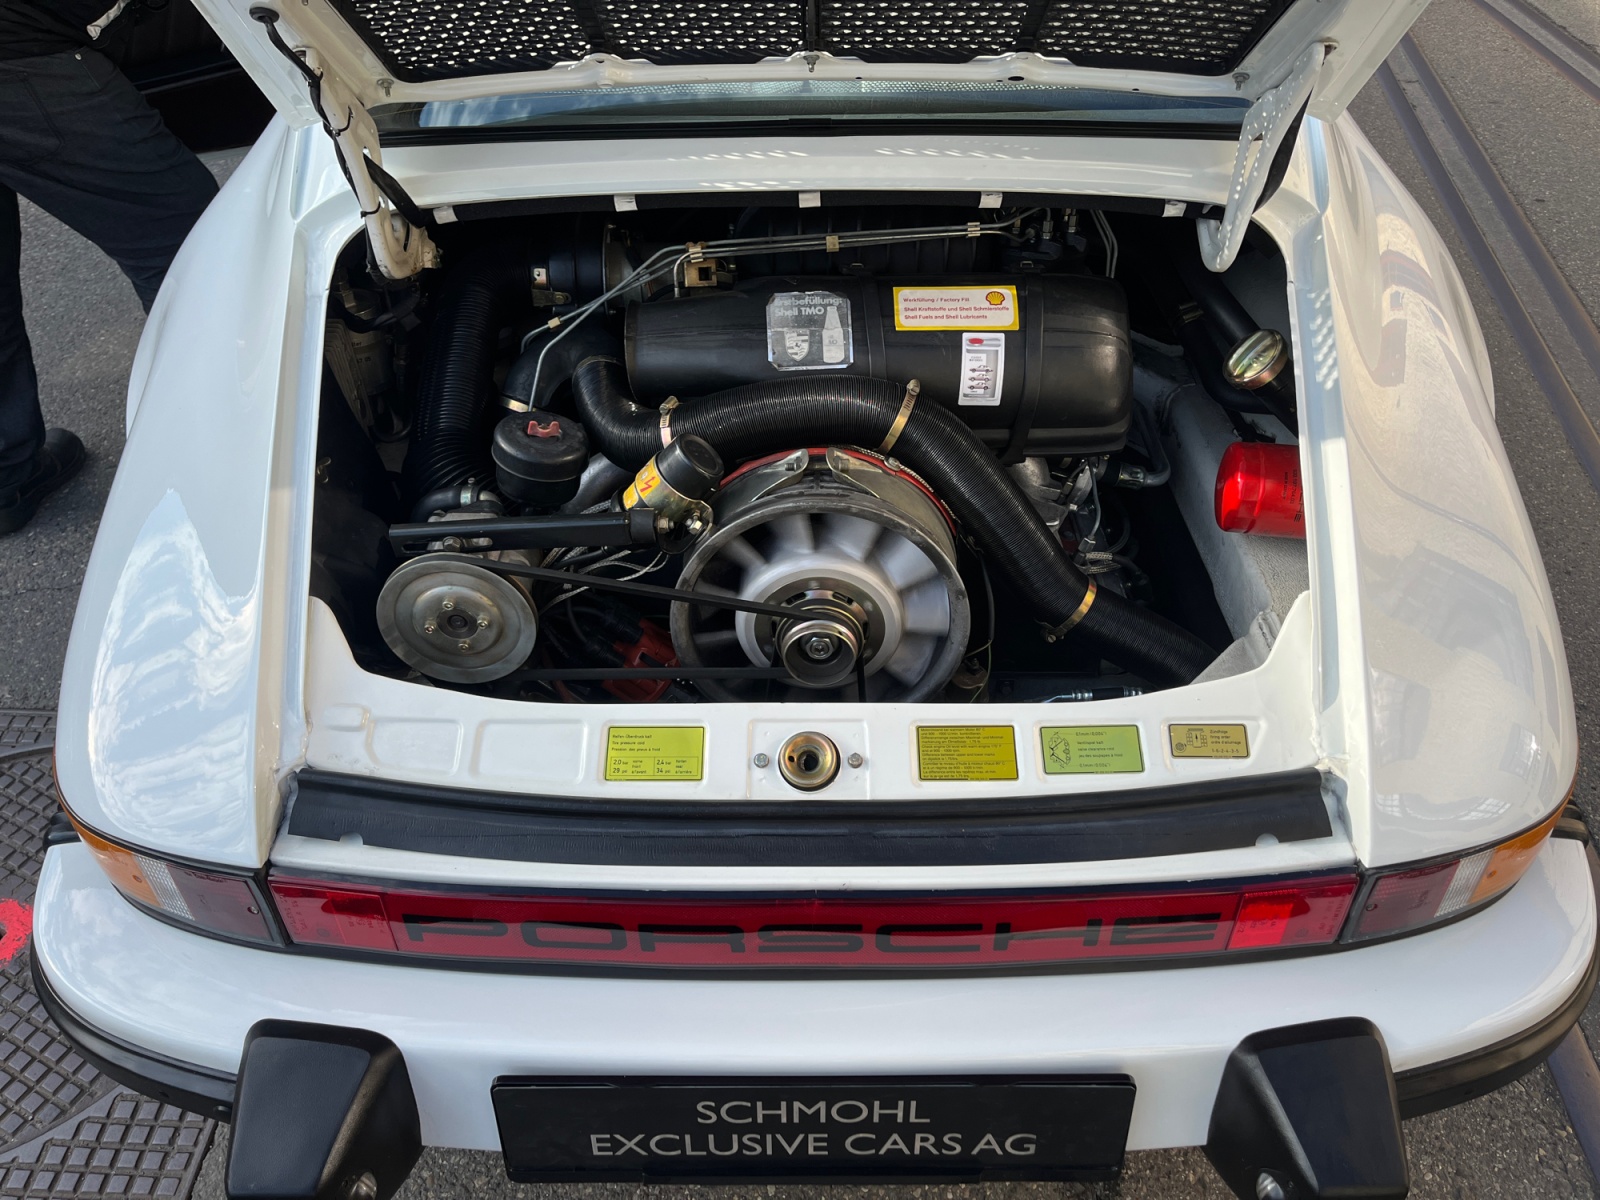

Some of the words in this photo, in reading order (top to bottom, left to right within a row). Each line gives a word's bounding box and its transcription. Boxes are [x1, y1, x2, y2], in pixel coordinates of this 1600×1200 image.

[775, 306, 798, 317] Shell
[800, 306, 825, 316] TMO
[403, 911, 1222, 953] PORSCHE
[696, 1100, 931, 1124] SCHMOHL
[590, 1133, 829, 1157] EXCLUSIVE
[845, 1133, 963, 1157] CARS
[971, 1133, 1037, 1157] AG
